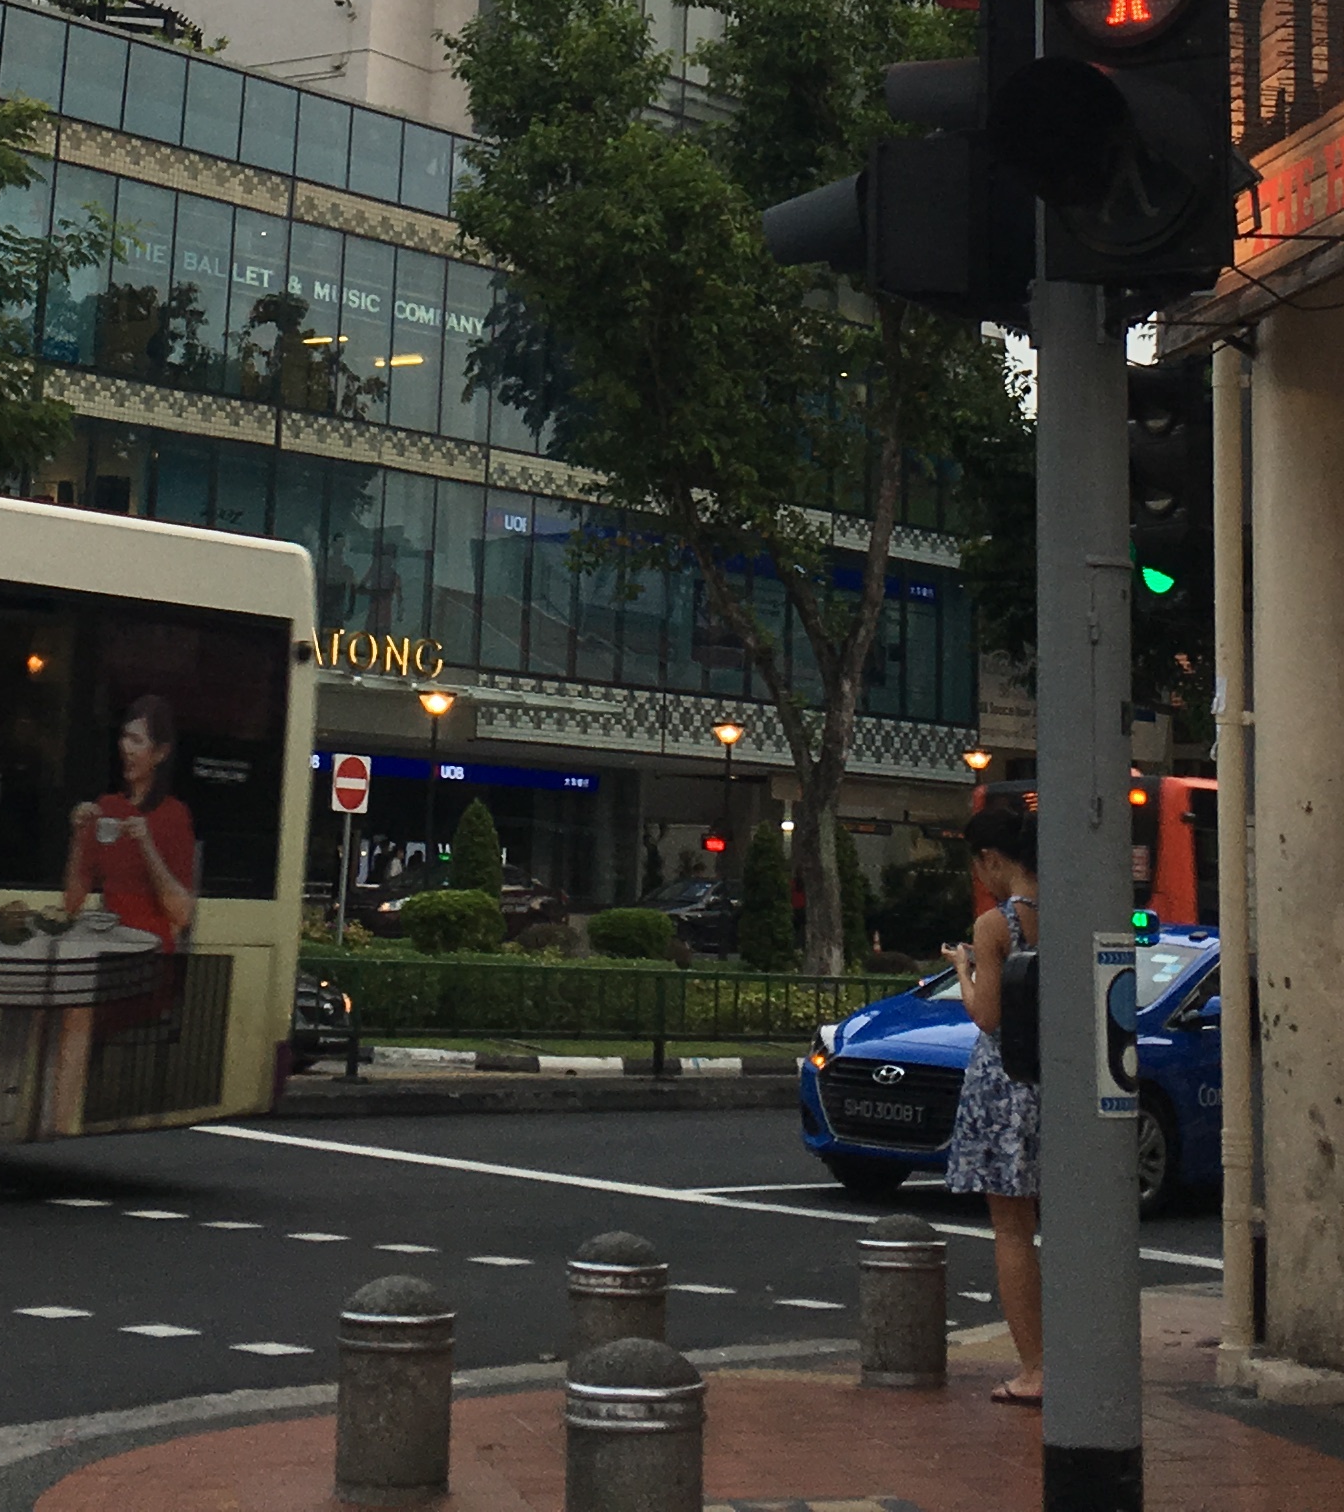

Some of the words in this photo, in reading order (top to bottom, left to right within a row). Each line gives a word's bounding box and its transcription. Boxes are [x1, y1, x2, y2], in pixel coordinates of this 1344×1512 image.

[1250, 156, 1316, 253] THE
[121, 237, 168, 265] THE
[183, 250, 274, 288] BALLET
[287, 275, 302, 296] &
[313, 280, 381, 313] MUSIC
[440, 765, 465, 780] UOB
